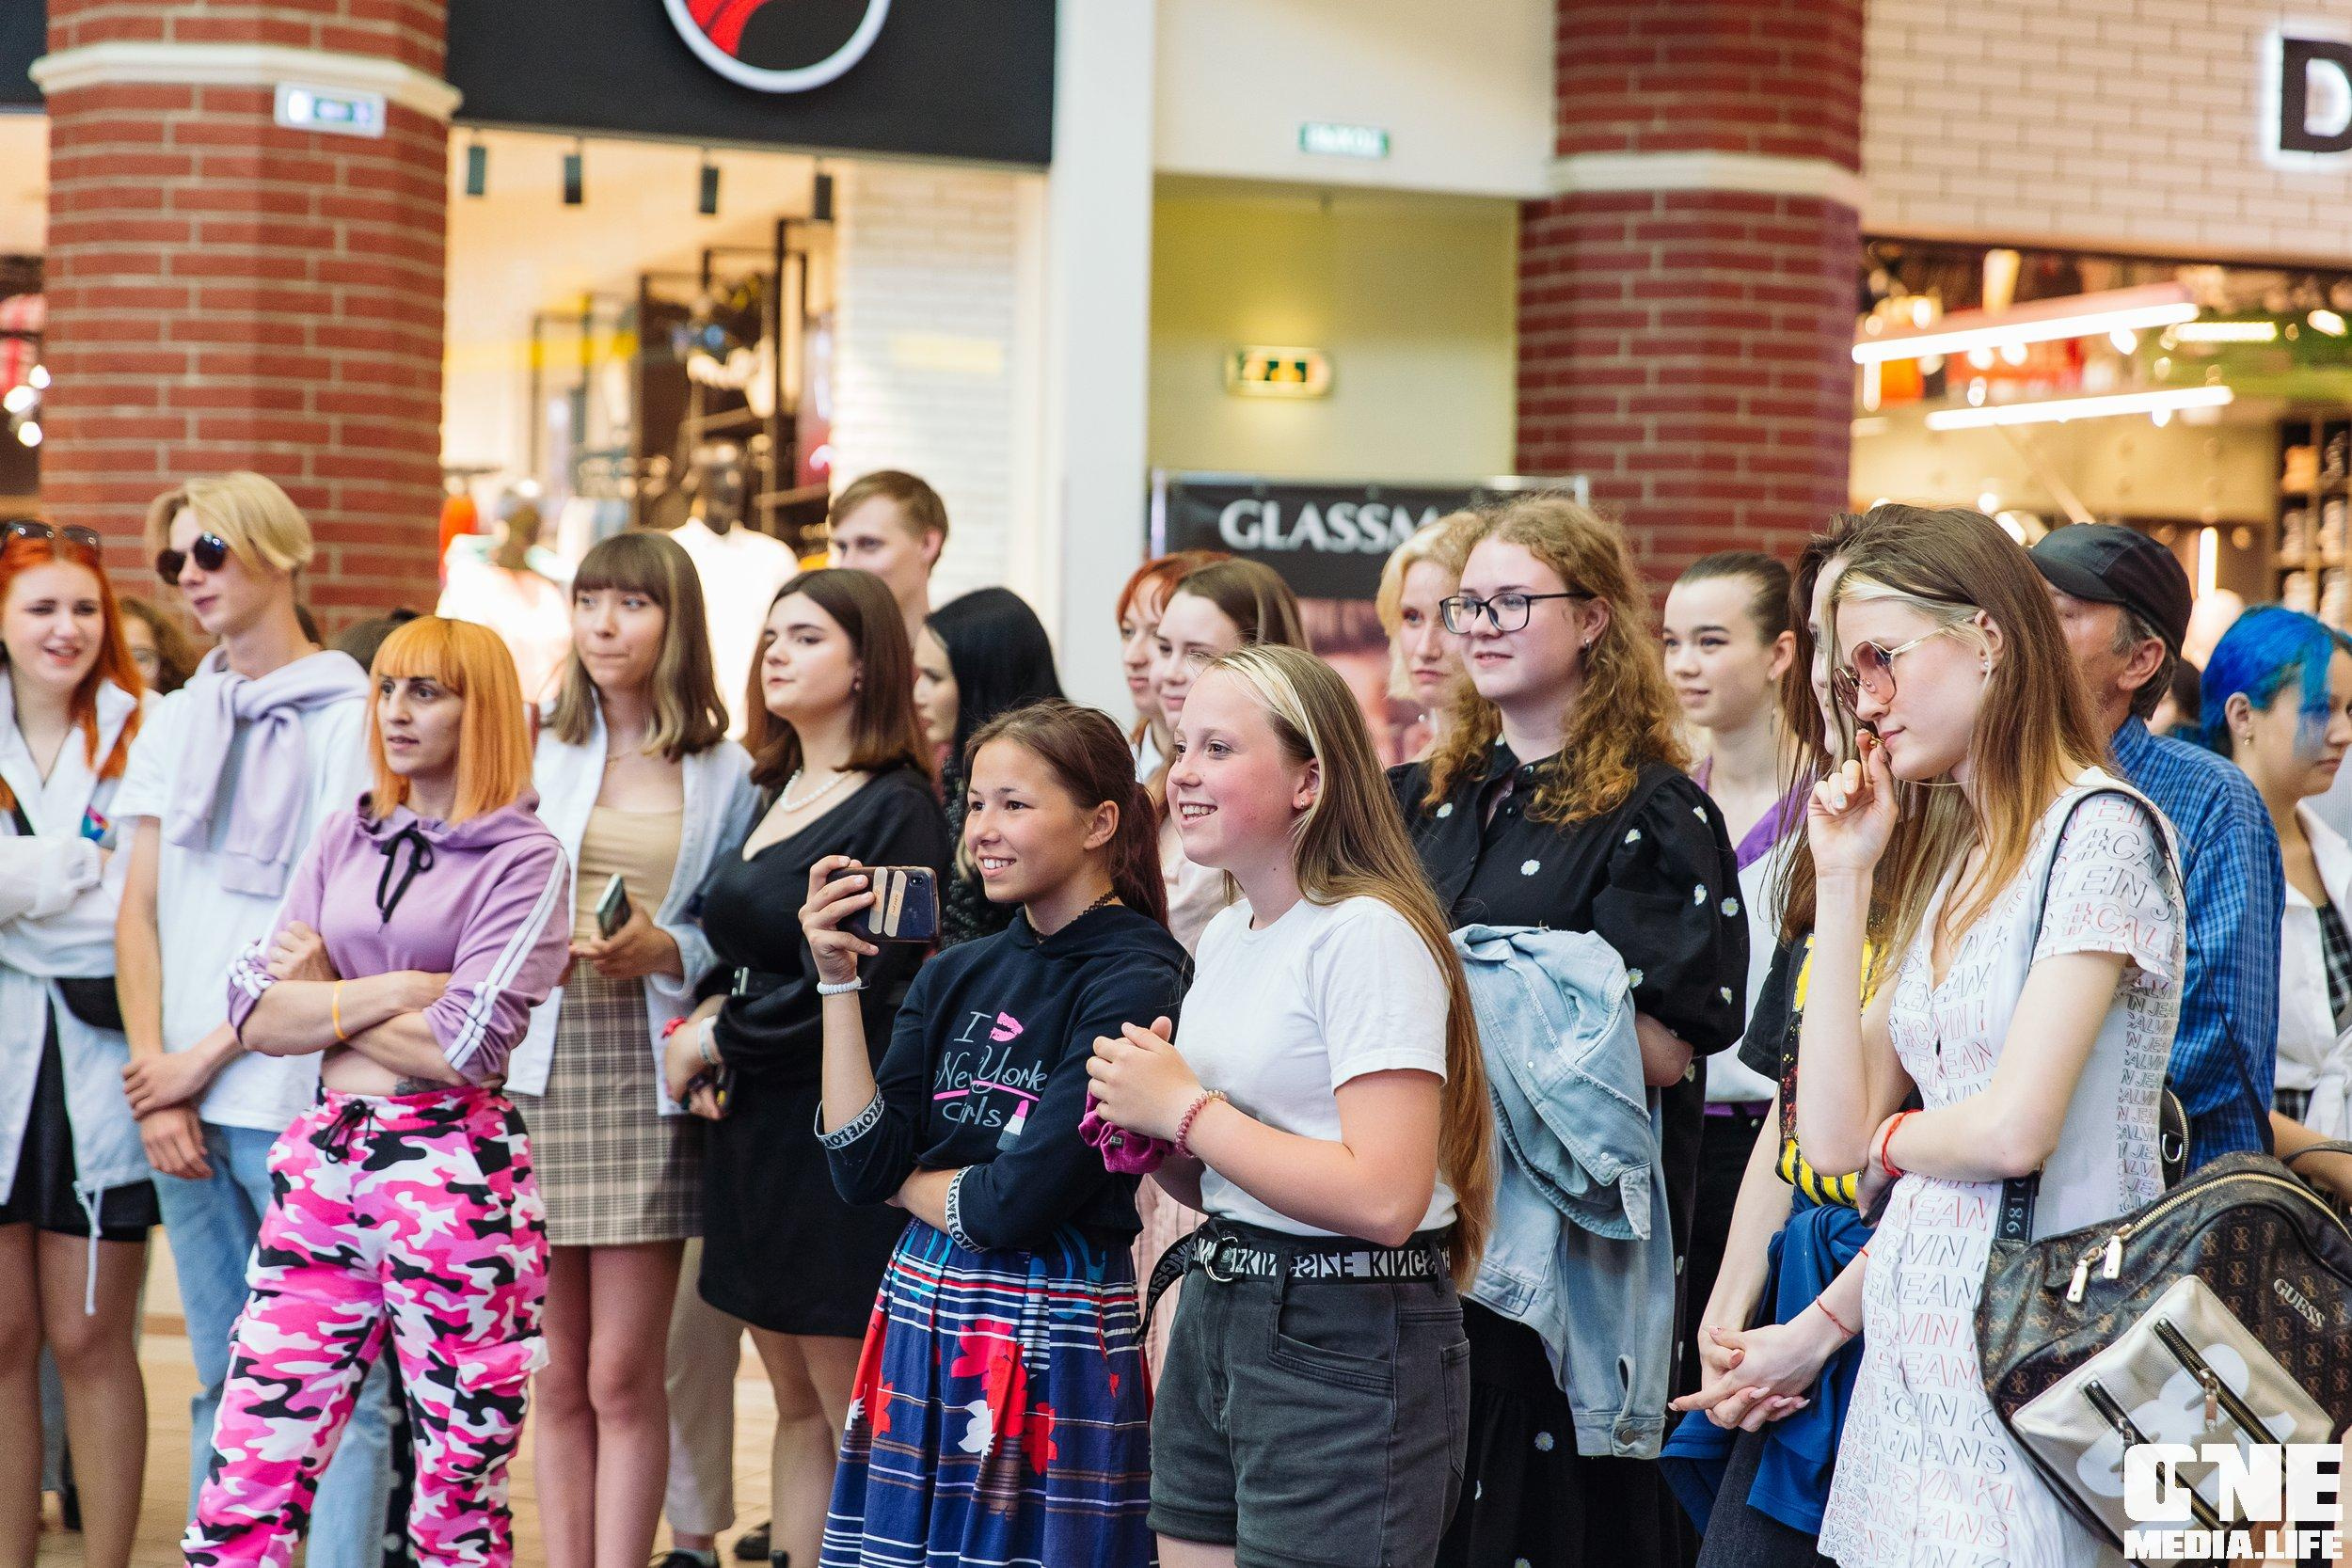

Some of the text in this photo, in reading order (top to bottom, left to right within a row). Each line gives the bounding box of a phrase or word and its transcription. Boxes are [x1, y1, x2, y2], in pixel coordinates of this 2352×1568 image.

[1218, 498, 1440, 555] GLASSM
[953, 1010, 993, 1043] I
[973, 1045, 1048, 1094] York
[2273, 1278, 2326, 1330] GUESS
